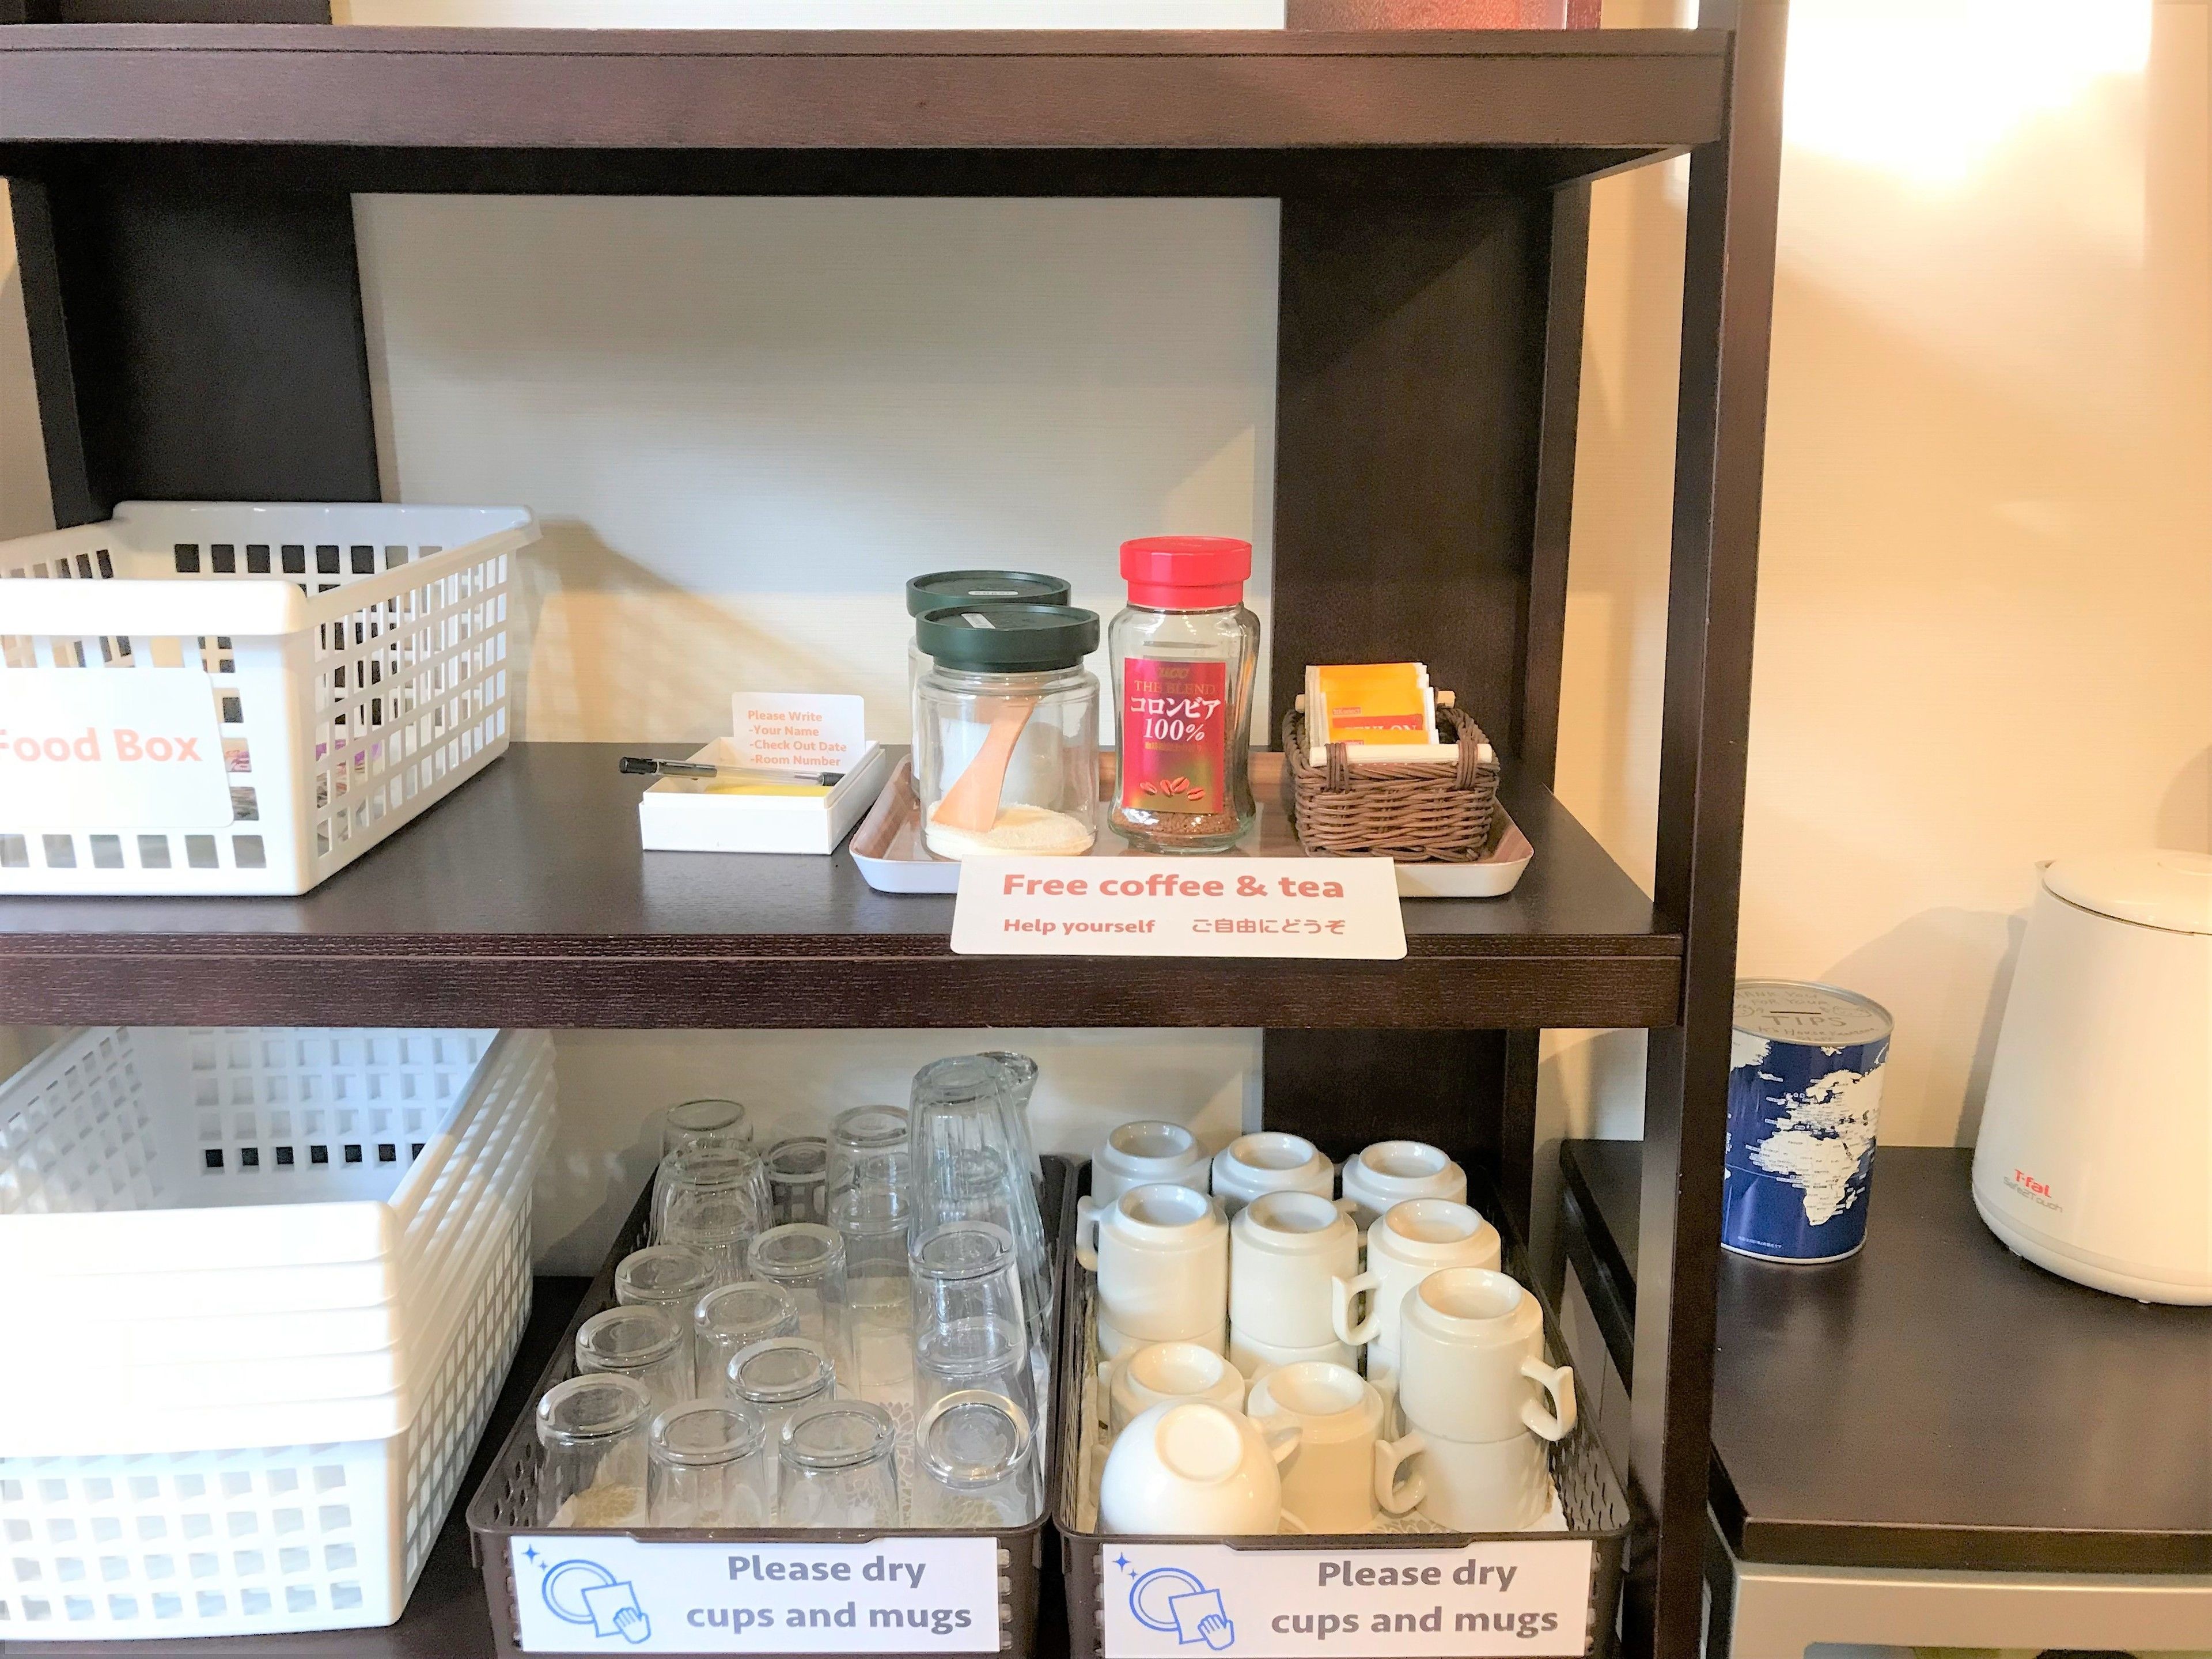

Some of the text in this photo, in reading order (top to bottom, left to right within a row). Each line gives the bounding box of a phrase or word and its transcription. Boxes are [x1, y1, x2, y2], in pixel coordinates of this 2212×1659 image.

[1134, 680, 1215, 695] THE BLEND
[747, 710, 823, 722] Please Write
[1130, 696, 1222, 721] コロンビア
[749, 725, 820, 736] -Your Name
[1143, 718, 1205, 742] 100%
[113, 729, 203, 762] Box
[749, 740, 847, 752] -Check Out Date
[751, 754, 841, 766] -Room Number
[1003, 874, 1344, 899] Free coffee & tea
[1003, 918, 1156, 935] Help yourself
[1192, 918, 1346, 935] ご自由にどうぞ
[1761, 1015, 1847, 1027] TIPS
[728, 1555, 927, 1589] Please dry
[1318, 1558, 1518, 1592] Please dry
[686, 1601, 972, 1635] cups and mugs
[1271, 1605, 1559, 1641] cups and mugs
